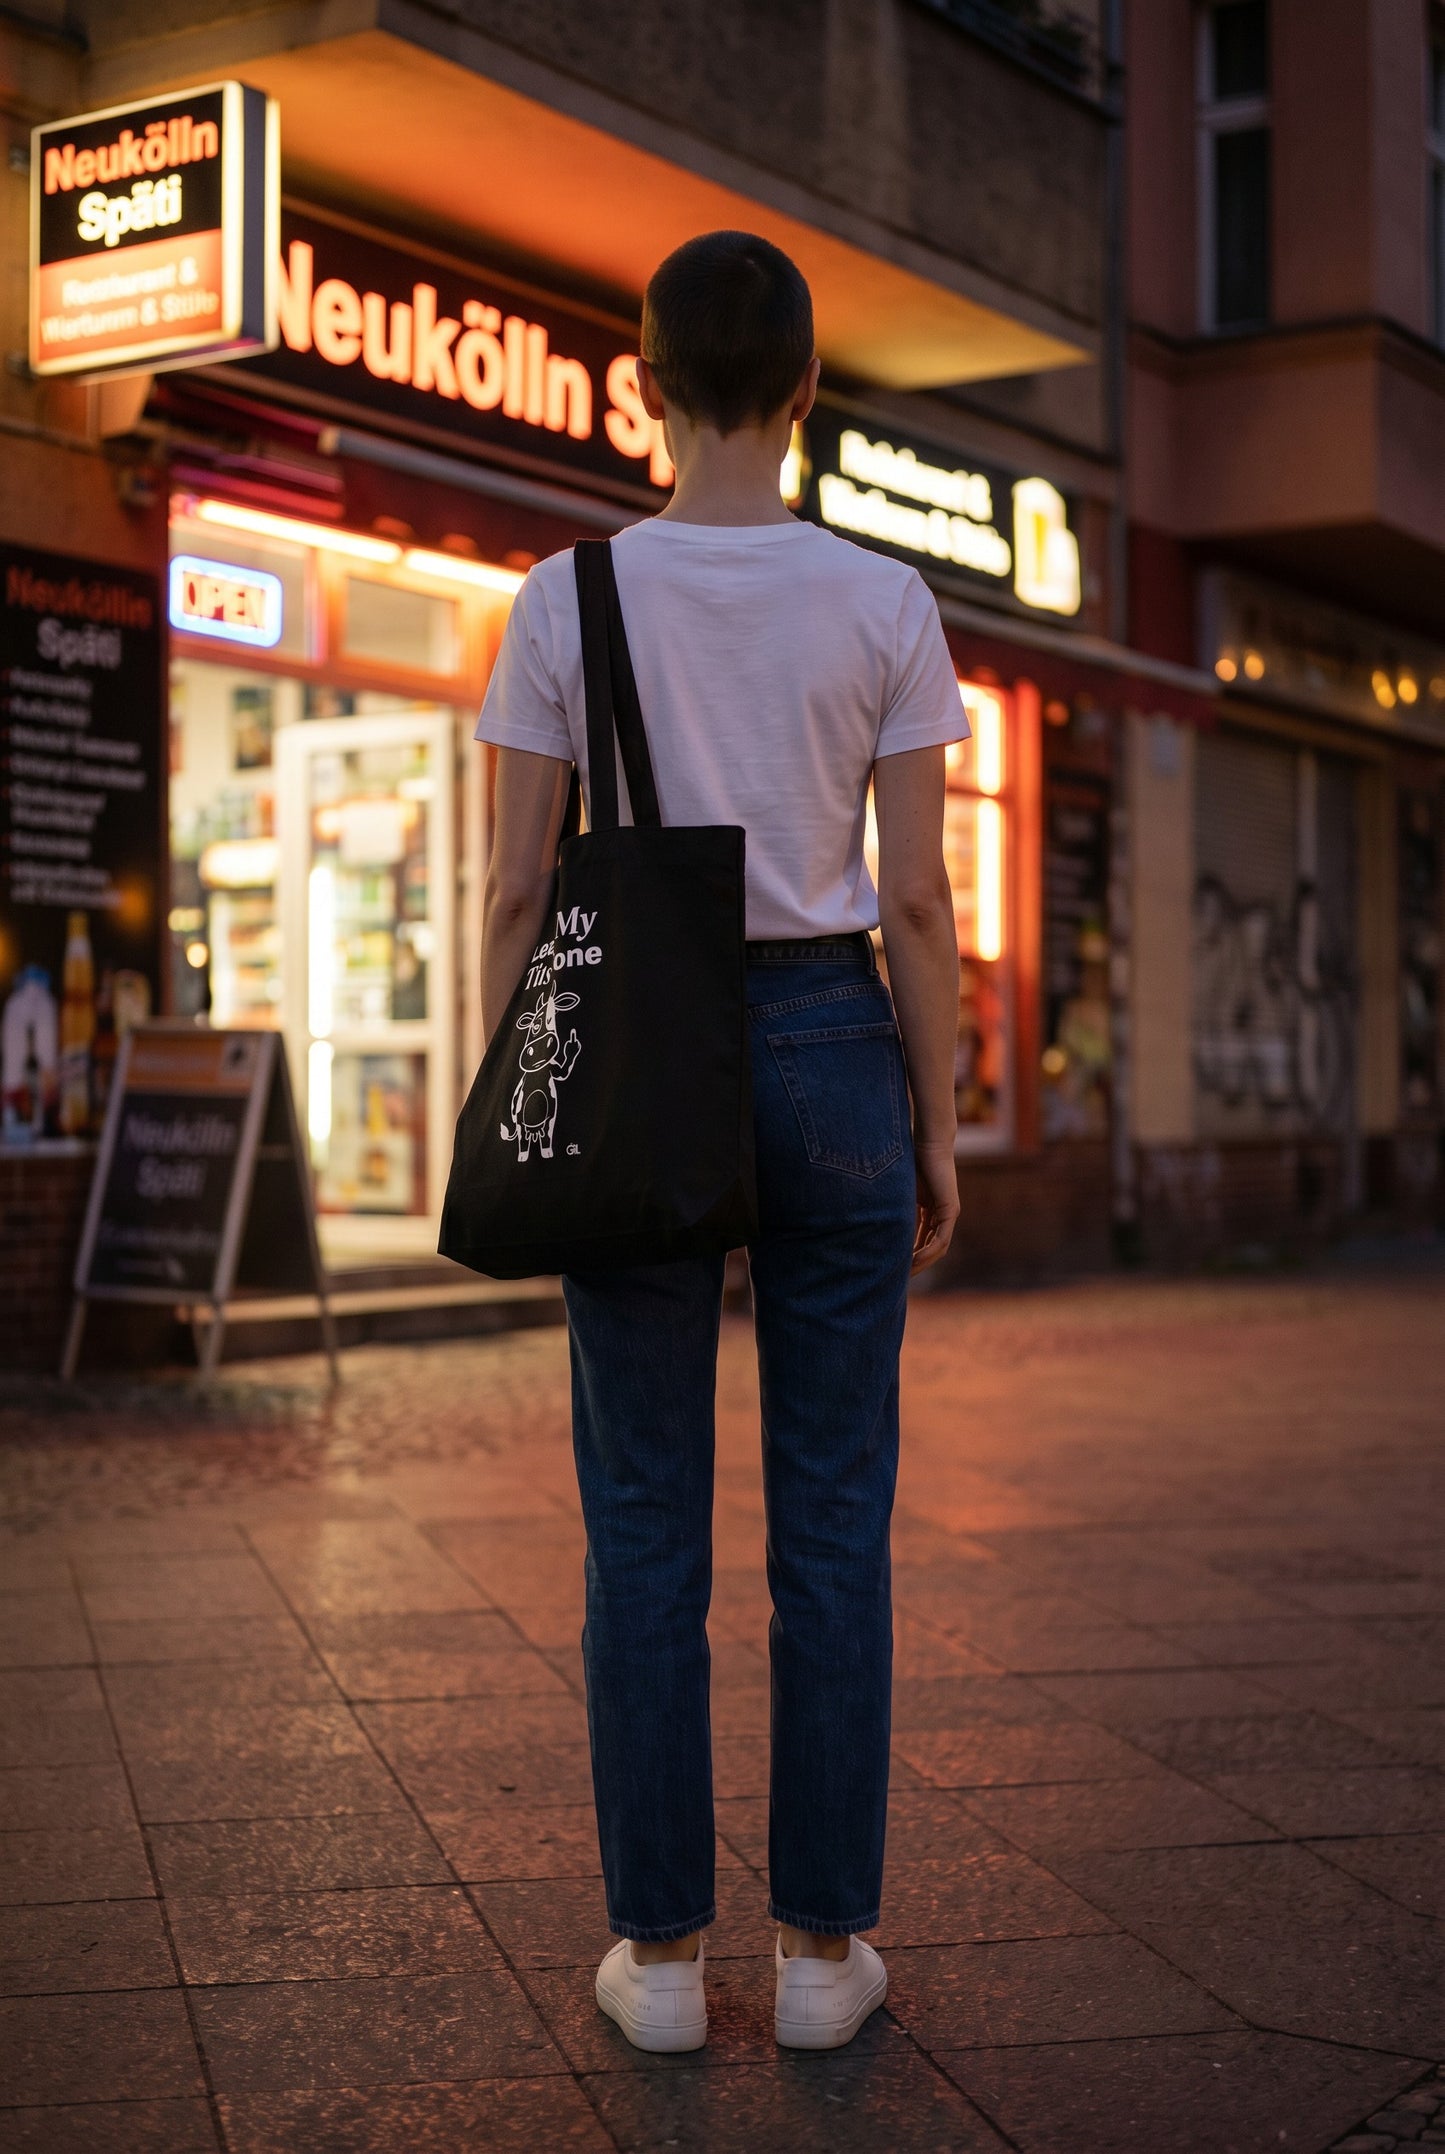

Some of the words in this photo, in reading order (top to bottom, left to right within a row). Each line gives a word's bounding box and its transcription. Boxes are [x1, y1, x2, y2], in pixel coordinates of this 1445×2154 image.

[45, 115, 218, 195] Neukölln
[77, 173, 182, 247] Späti
[279, 240, 592, 441] Neukölln
[182, 571, 267, 630] OPEN
[555, 906, 598, 942] My
[525, 963, 553, 991] Tits
[553, 946, 602, 971] one
